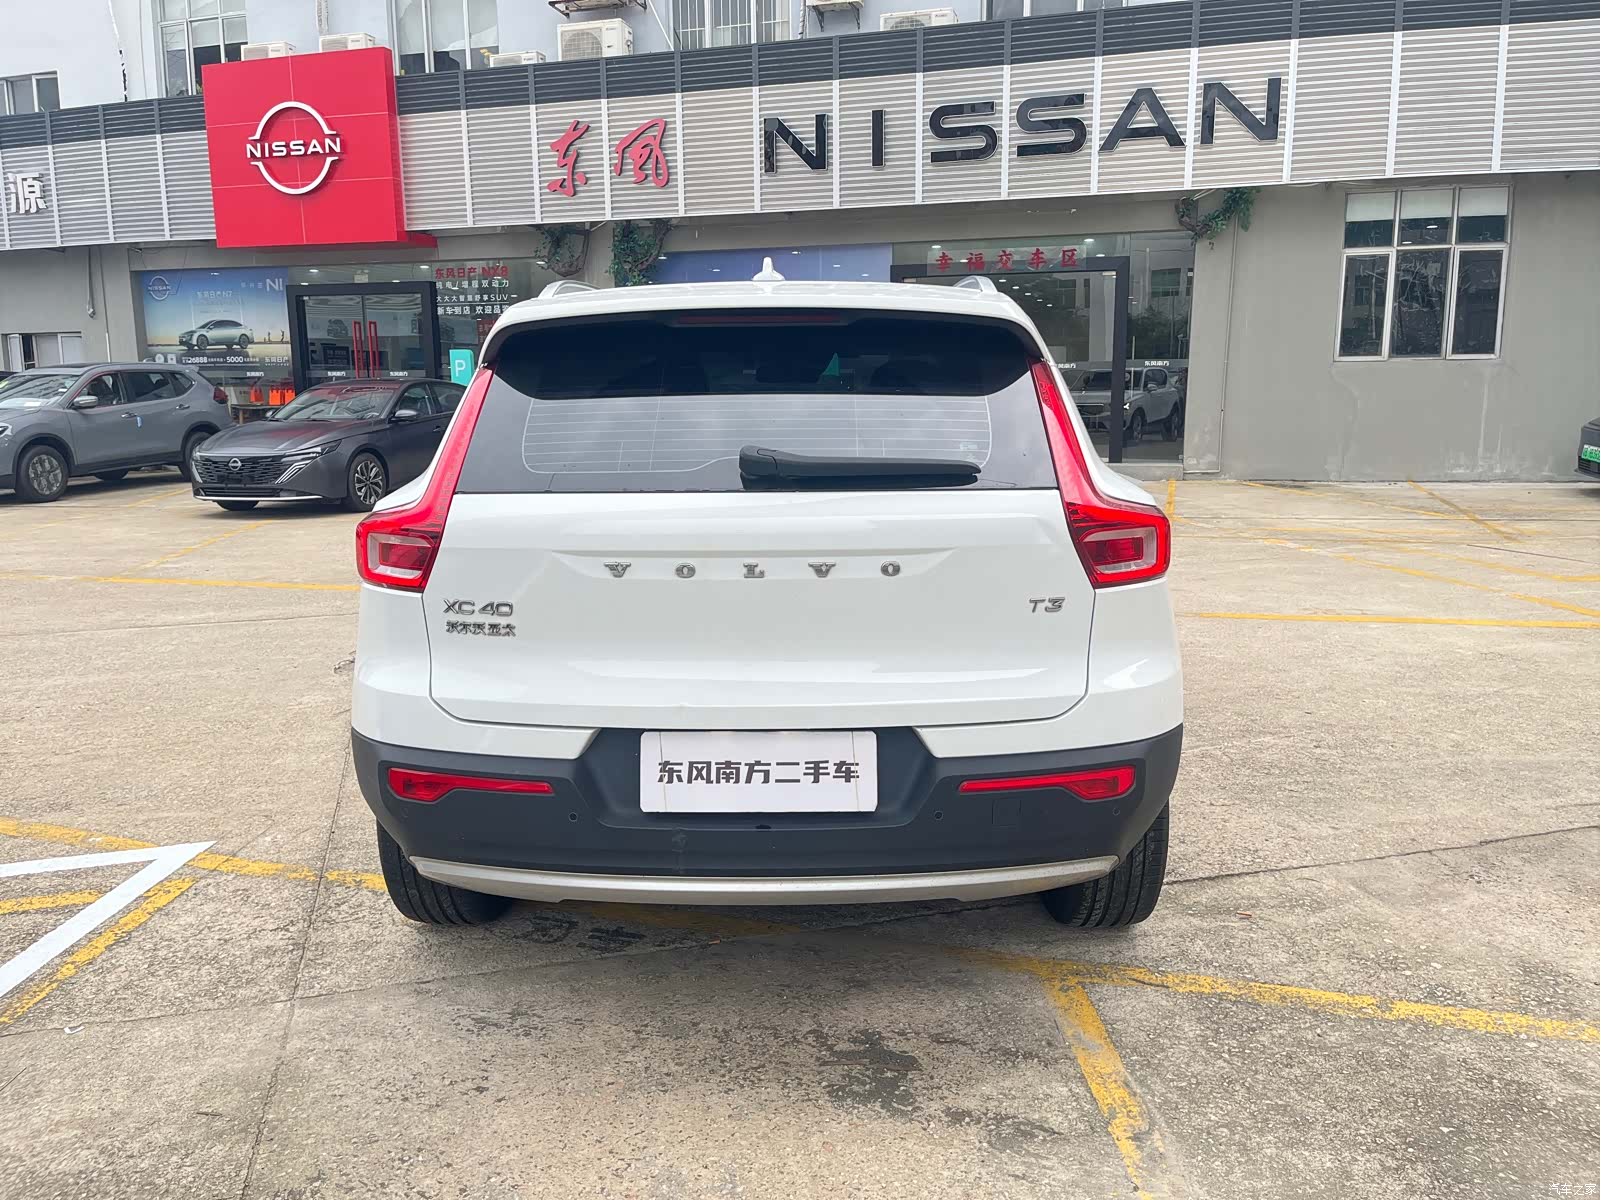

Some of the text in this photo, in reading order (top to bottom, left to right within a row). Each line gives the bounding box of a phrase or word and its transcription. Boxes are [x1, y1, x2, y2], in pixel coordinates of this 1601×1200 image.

[763, 76, 1281, 174] NISSAN
[246, 138, 341, 158] NISSAN
[7, 173, 47, 214] 源
[936, 248, 1078, 272] 幸福交车区
[435, 266, 508, 279] 东风日产 NX8
[437, 306, 470, 315] 新车到店
[455, 360, 466, 377] P
[603, 560, 901, 579] VOLVO
[1029, 596, 1066, 613] T3
[446, 620, 516, 637] 沃尔沃亚太
[657, 760, 860, 784] 东风南方二手车
